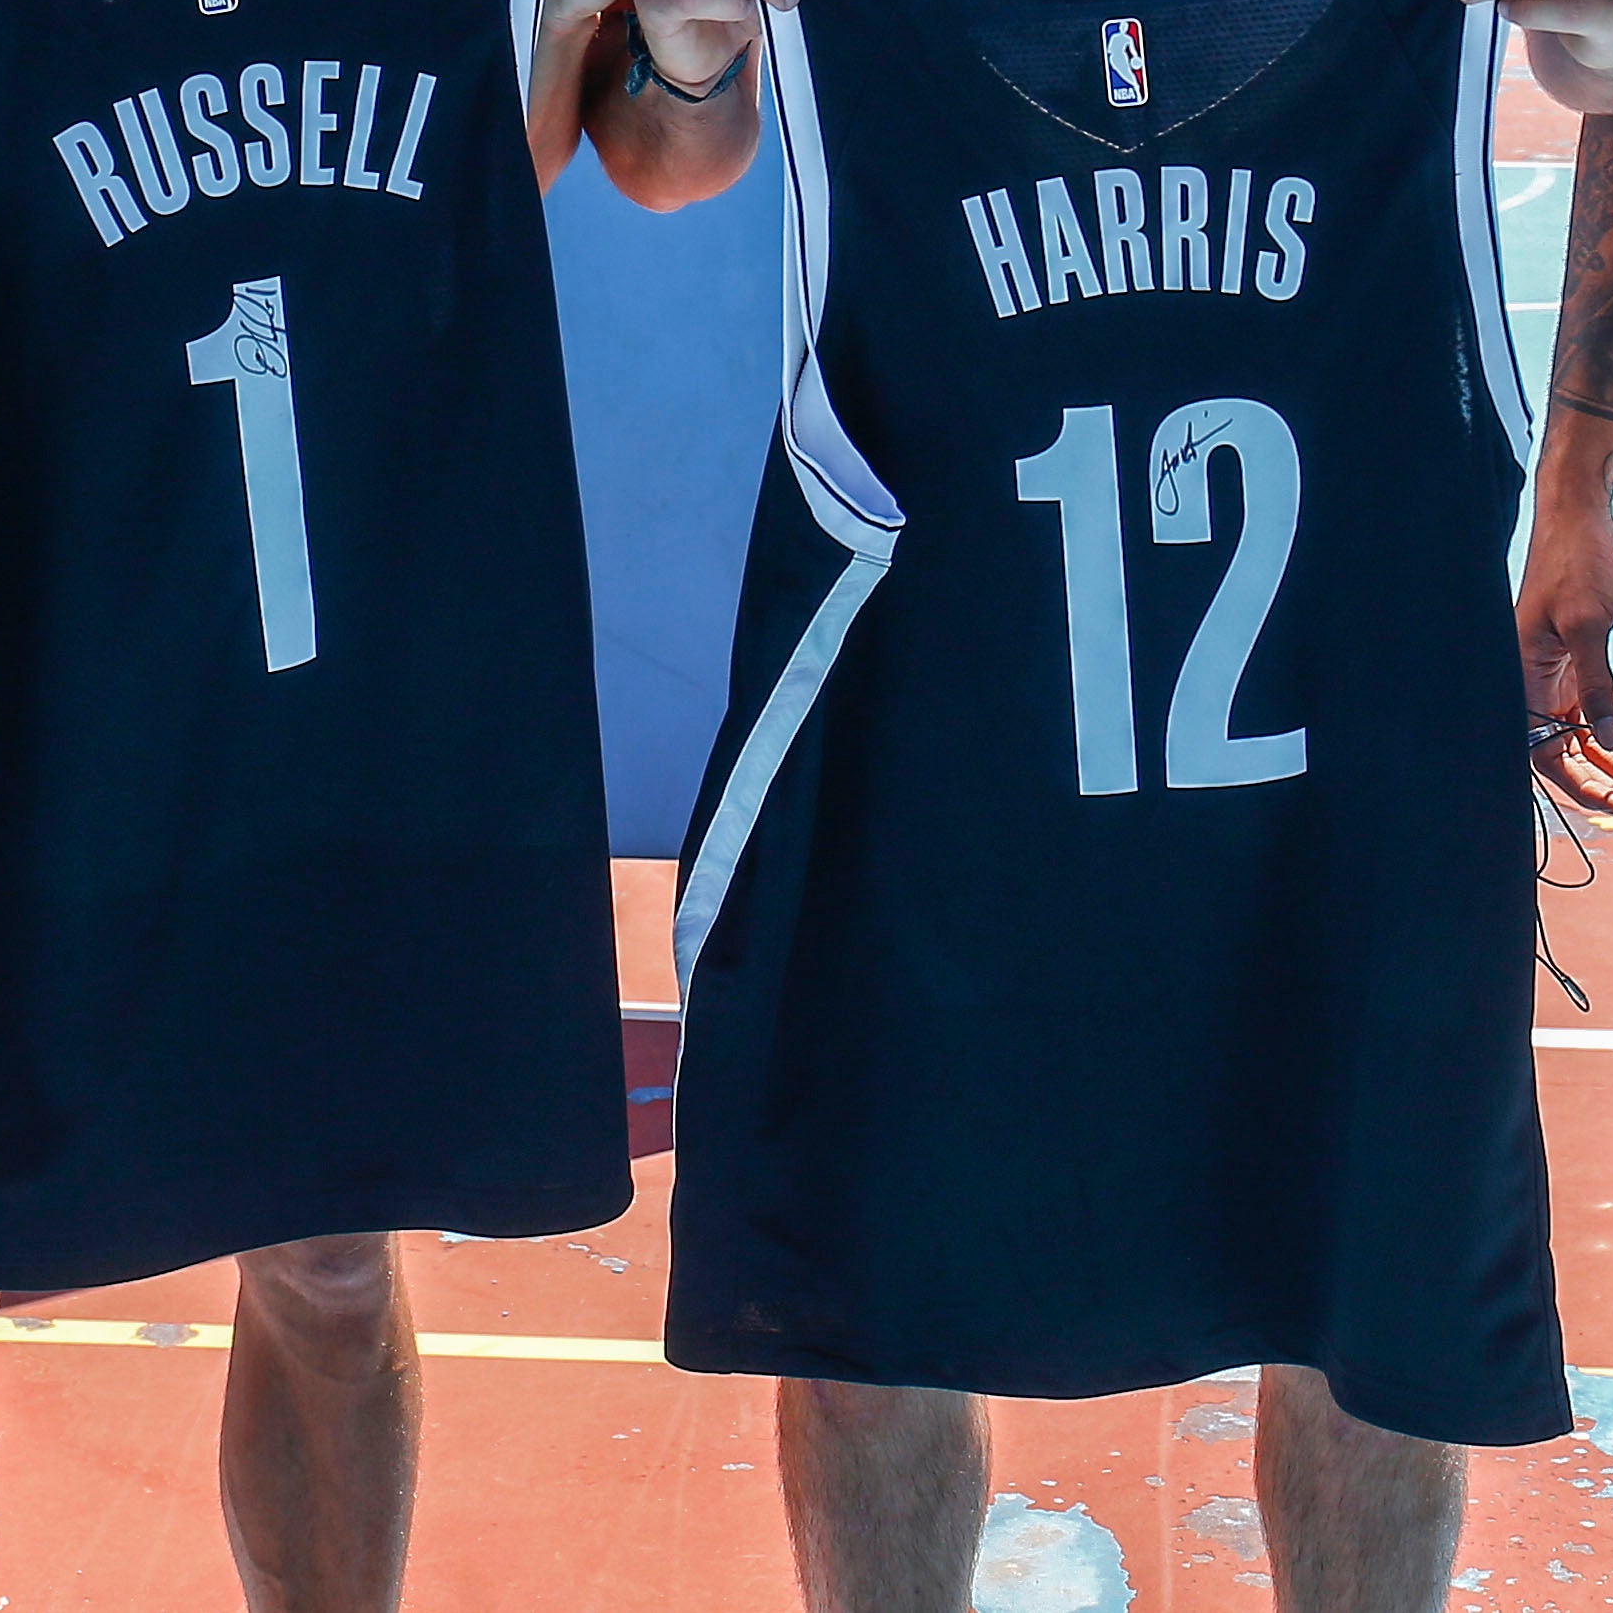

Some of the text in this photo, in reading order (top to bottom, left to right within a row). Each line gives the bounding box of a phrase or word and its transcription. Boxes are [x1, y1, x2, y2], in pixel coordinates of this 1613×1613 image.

[52, 60, 437, 248] RUSSELL
[1113, 87, 1136, 101] NBA
[962, 165, 1316, 318] HARRIS
[185, 275, 318, 673] 1
[1015, 396, 1308, 796] 12
